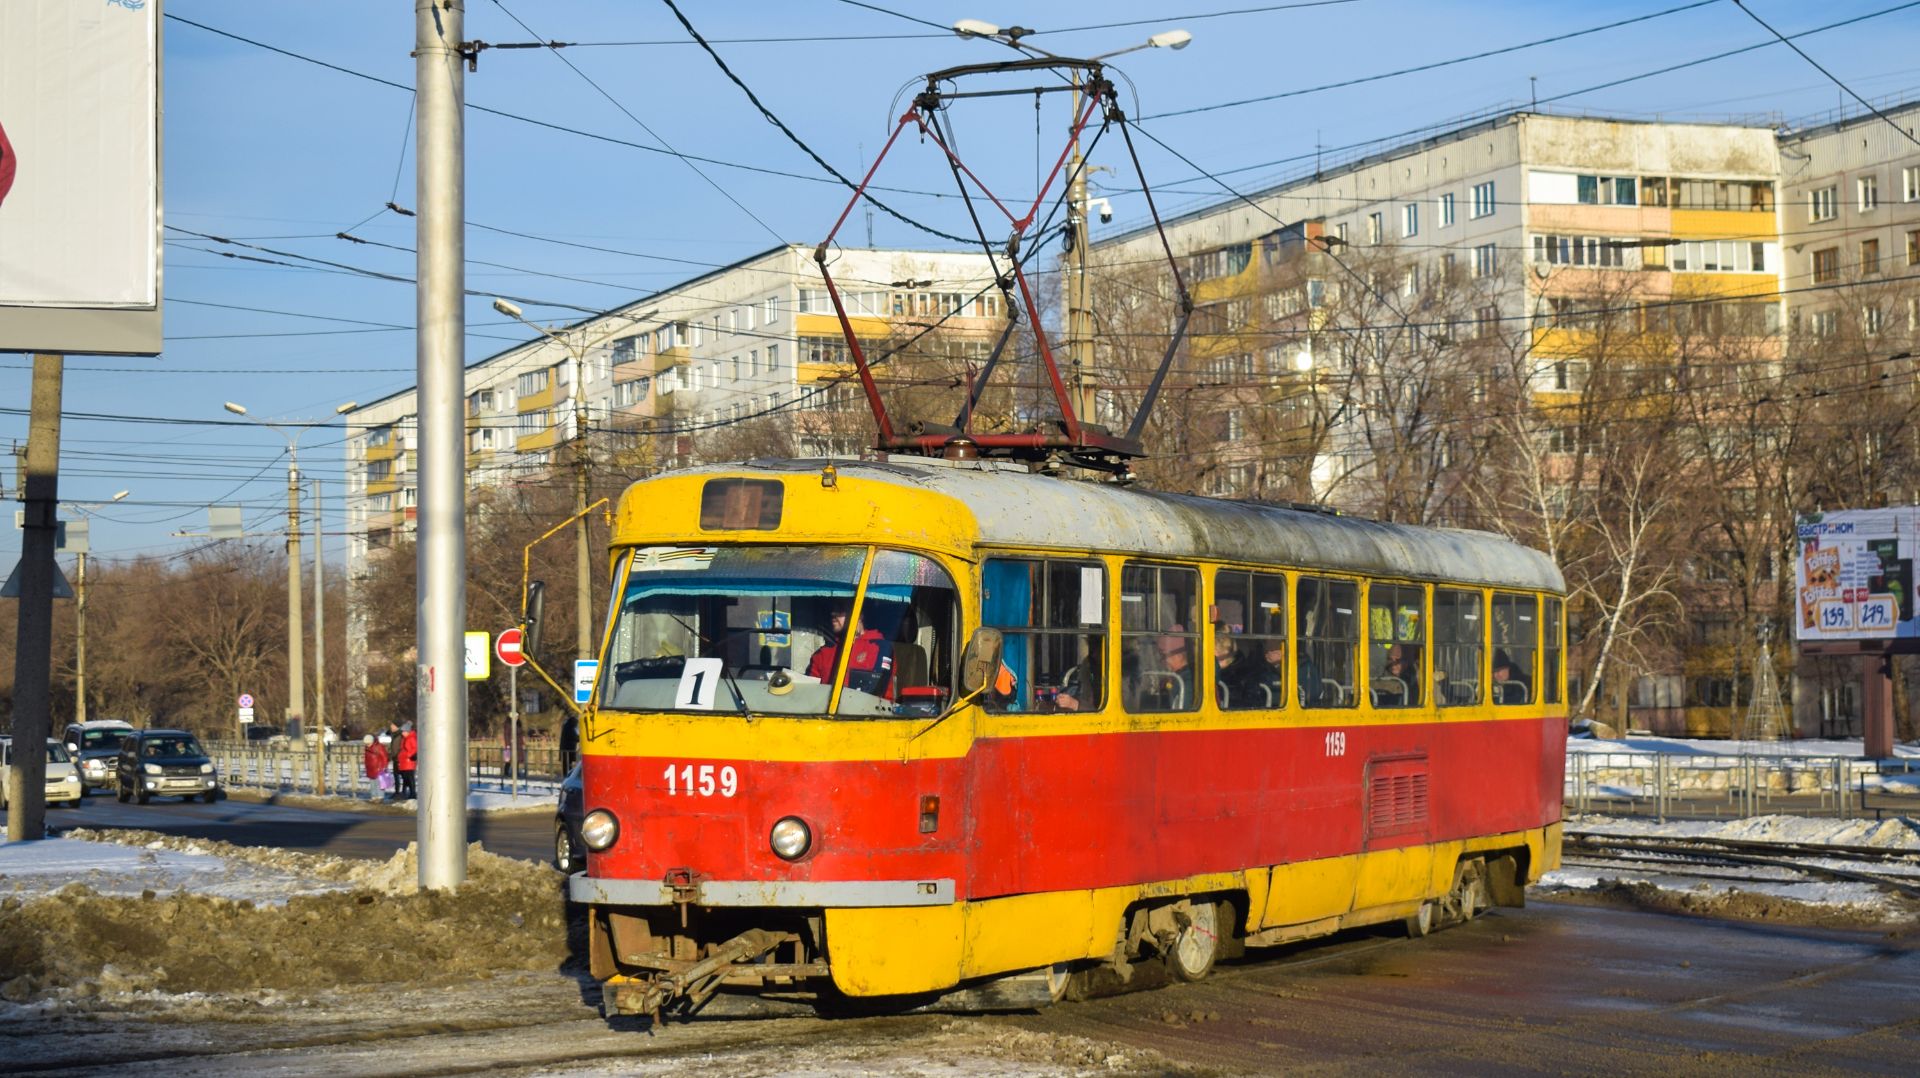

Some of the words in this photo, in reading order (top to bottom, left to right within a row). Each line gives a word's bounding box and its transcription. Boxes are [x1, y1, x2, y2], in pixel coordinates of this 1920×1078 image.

[1823, 607, 1844, 626] 139
[1862, 604, 1884, 625] 279
[685, 670, 706, 705] 1
[1326, 731, 1346, 757] 1159
[663, 764, 738, 797] 1159
